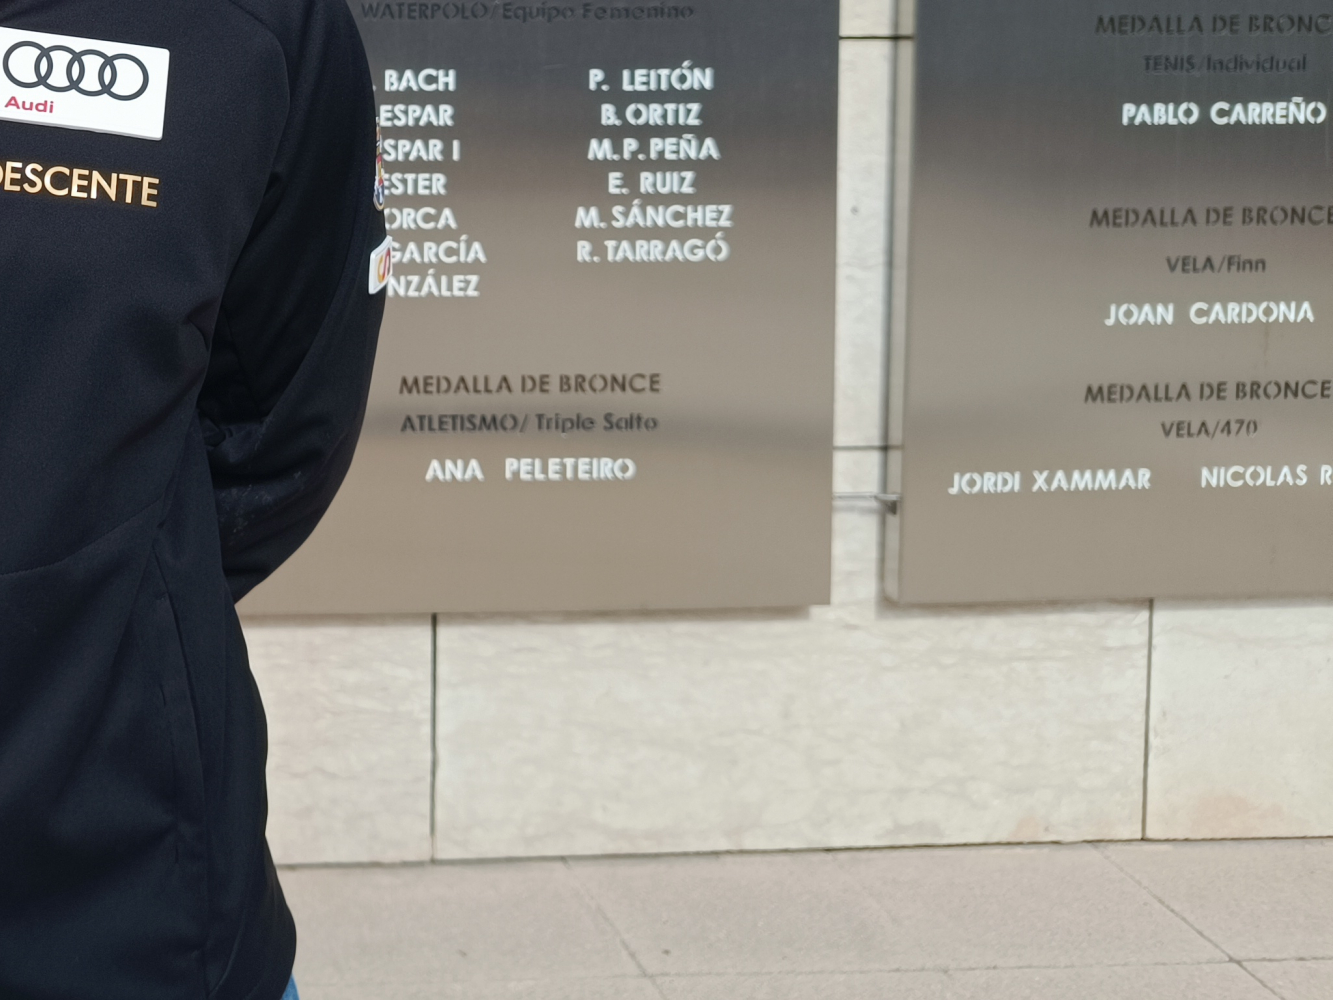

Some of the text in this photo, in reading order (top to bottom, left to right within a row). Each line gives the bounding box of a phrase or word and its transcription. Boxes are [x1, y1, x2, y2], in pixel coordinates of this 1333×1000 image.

[582, 2, 695, 20] Femenino
[1095, 13, 1333, 36] MEDALLA DE BRONC
[385, 68, 455, 91] BACH
[589, 60, 713, 91] P. LEITÓN
[4, 95, 55, 114] Audi
[626, 103, 701, 125] ORTIZ
[1122, 97, 1327, 125] PABLO CARREÑO
[609, 171, 694, 194] E. RUIZ
[575, 199, 732, 228] M. SÁNCHEZ
[1089, 208, 1197, 228] MEDALLA
[1206, 206, 1233, 226] DE
[604, 232, 729, 262] TARRAGÓ
[1105, 301, 1314, 326] JOAN CARDONA
[400, 373, 660, 394] MEDALLA DE BRONCE
[1084, 380, 1333, 403] MEDALLA DE BRONCE
[537, 414, 595, 433] Triple
[603, 414, 658, 431] Salto
[426, 457, 635, 481] ANA PELETEIRO
[1201, 464, 1307, 487] NICOLAS
[948, 468, 1151, 494] JORDI XAMMAR
